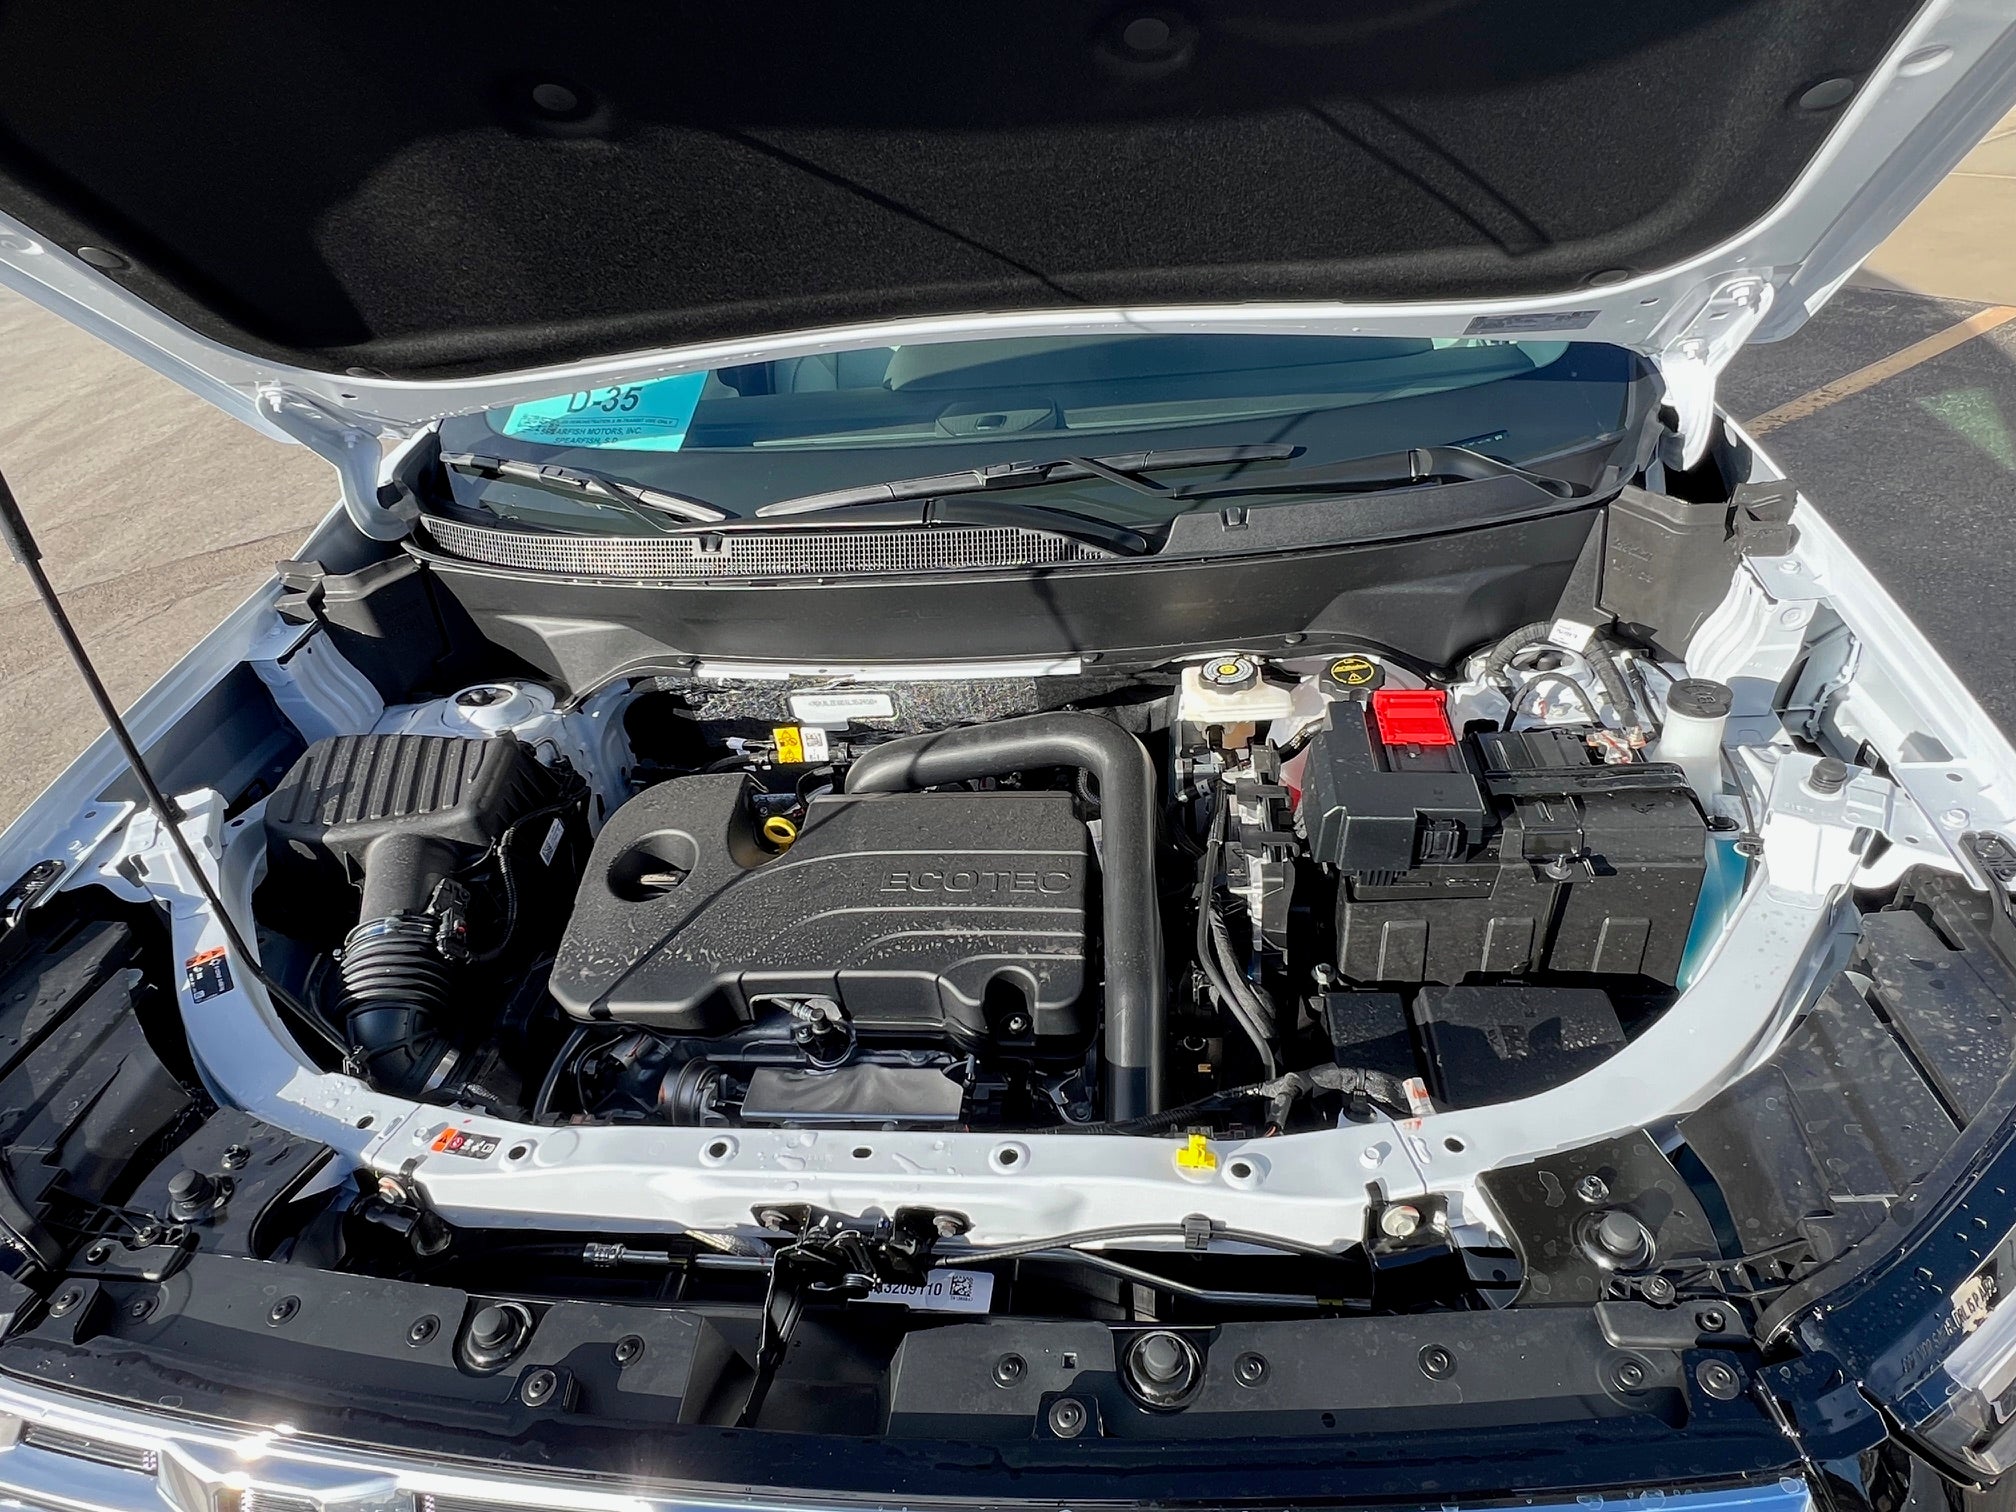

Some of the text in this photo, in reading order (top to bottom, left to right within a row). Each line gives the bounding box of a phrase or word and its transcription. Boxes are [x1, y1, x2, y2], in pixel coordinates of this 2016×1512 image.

[567, 387, 643, 412] D-35
[586, 427, 624, 436] MOTORS,
[880, 870, 1072, 894] ECOTEC
